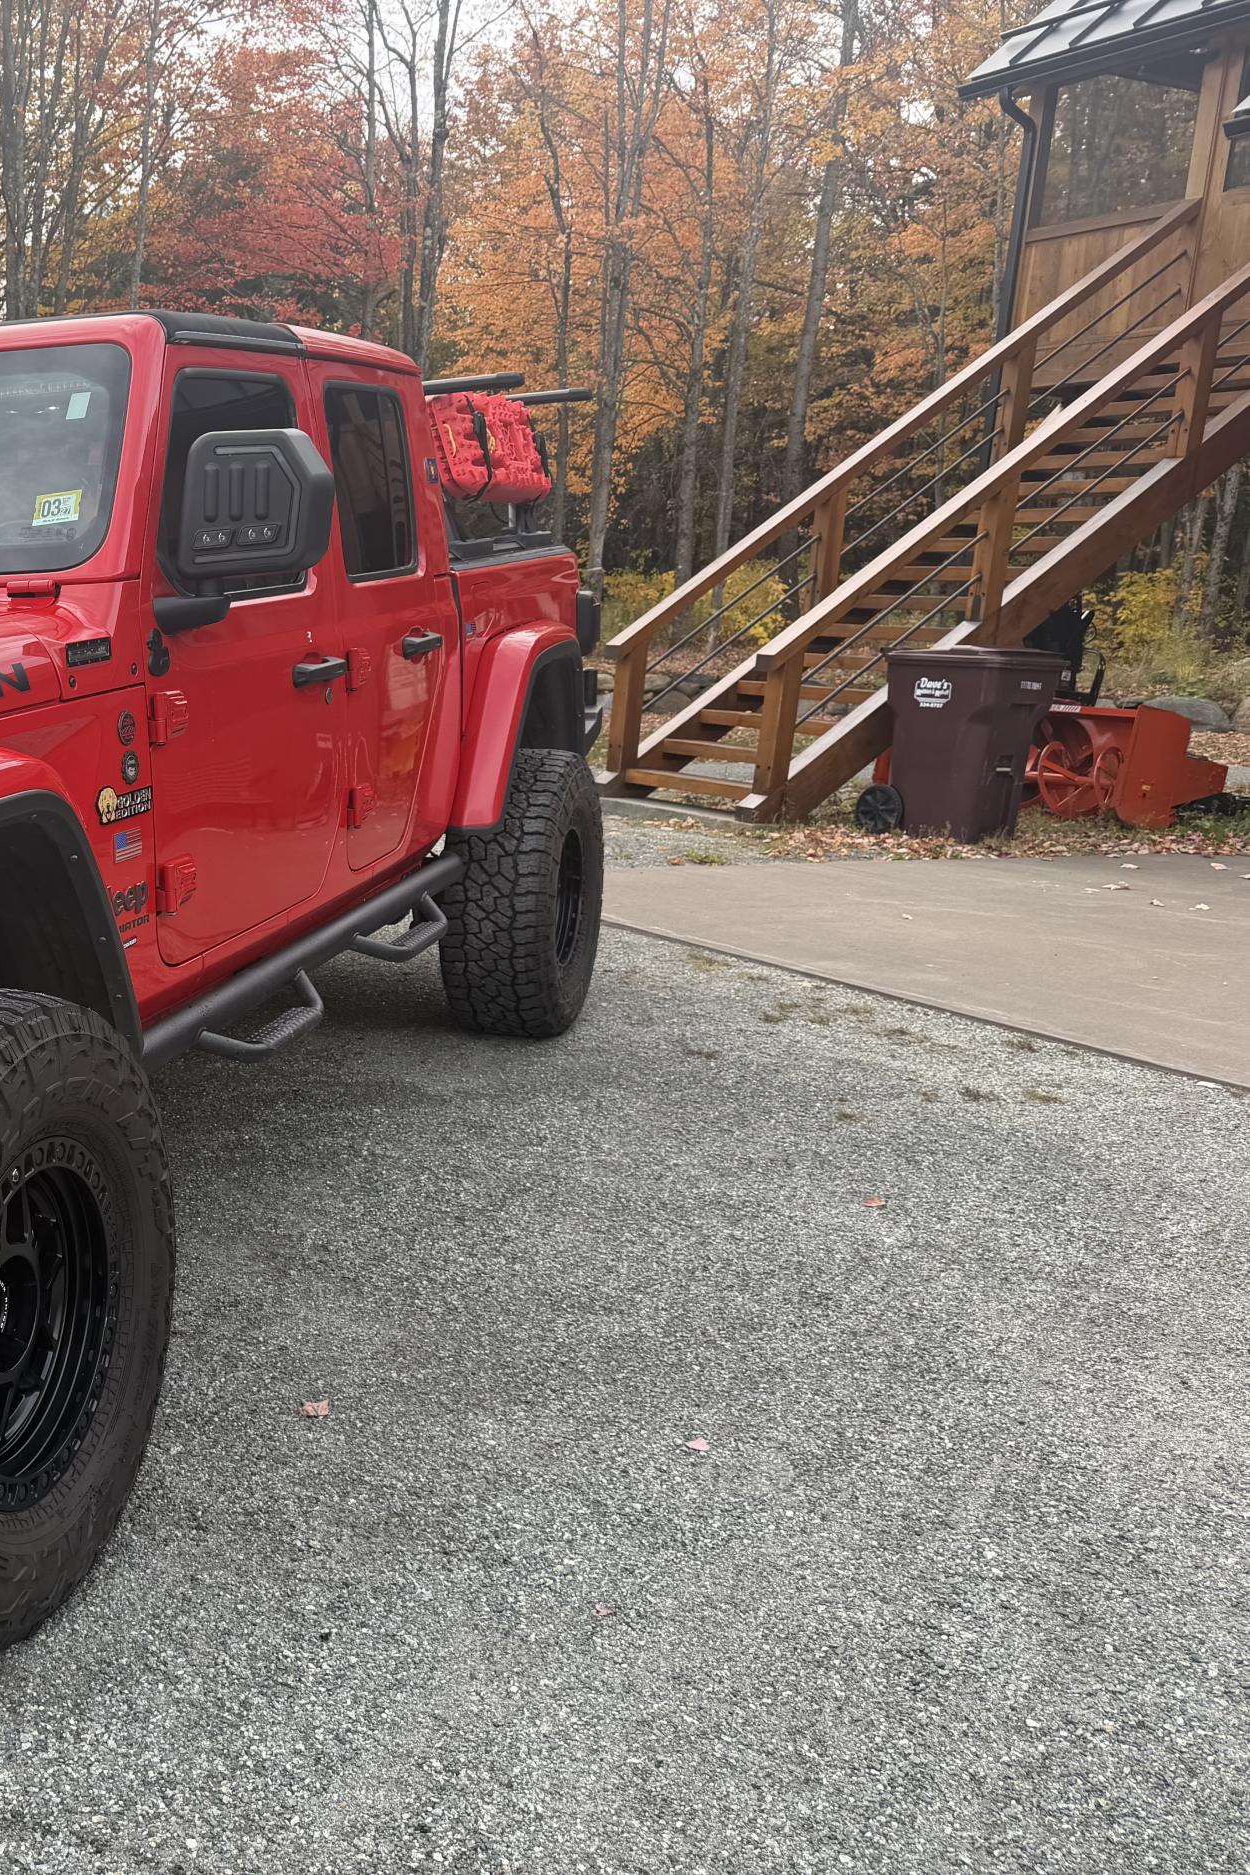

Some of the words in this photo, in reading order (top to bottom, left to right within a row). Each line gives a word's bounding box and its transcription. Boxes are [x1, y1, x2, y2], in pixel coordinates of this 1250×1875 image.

[42, 499, 61, 518] 03
[919, 677, 948, 690] Dave's
[117, 787, 152, 809] GOLDEN
[115, 800, 151, 820] EDITION
